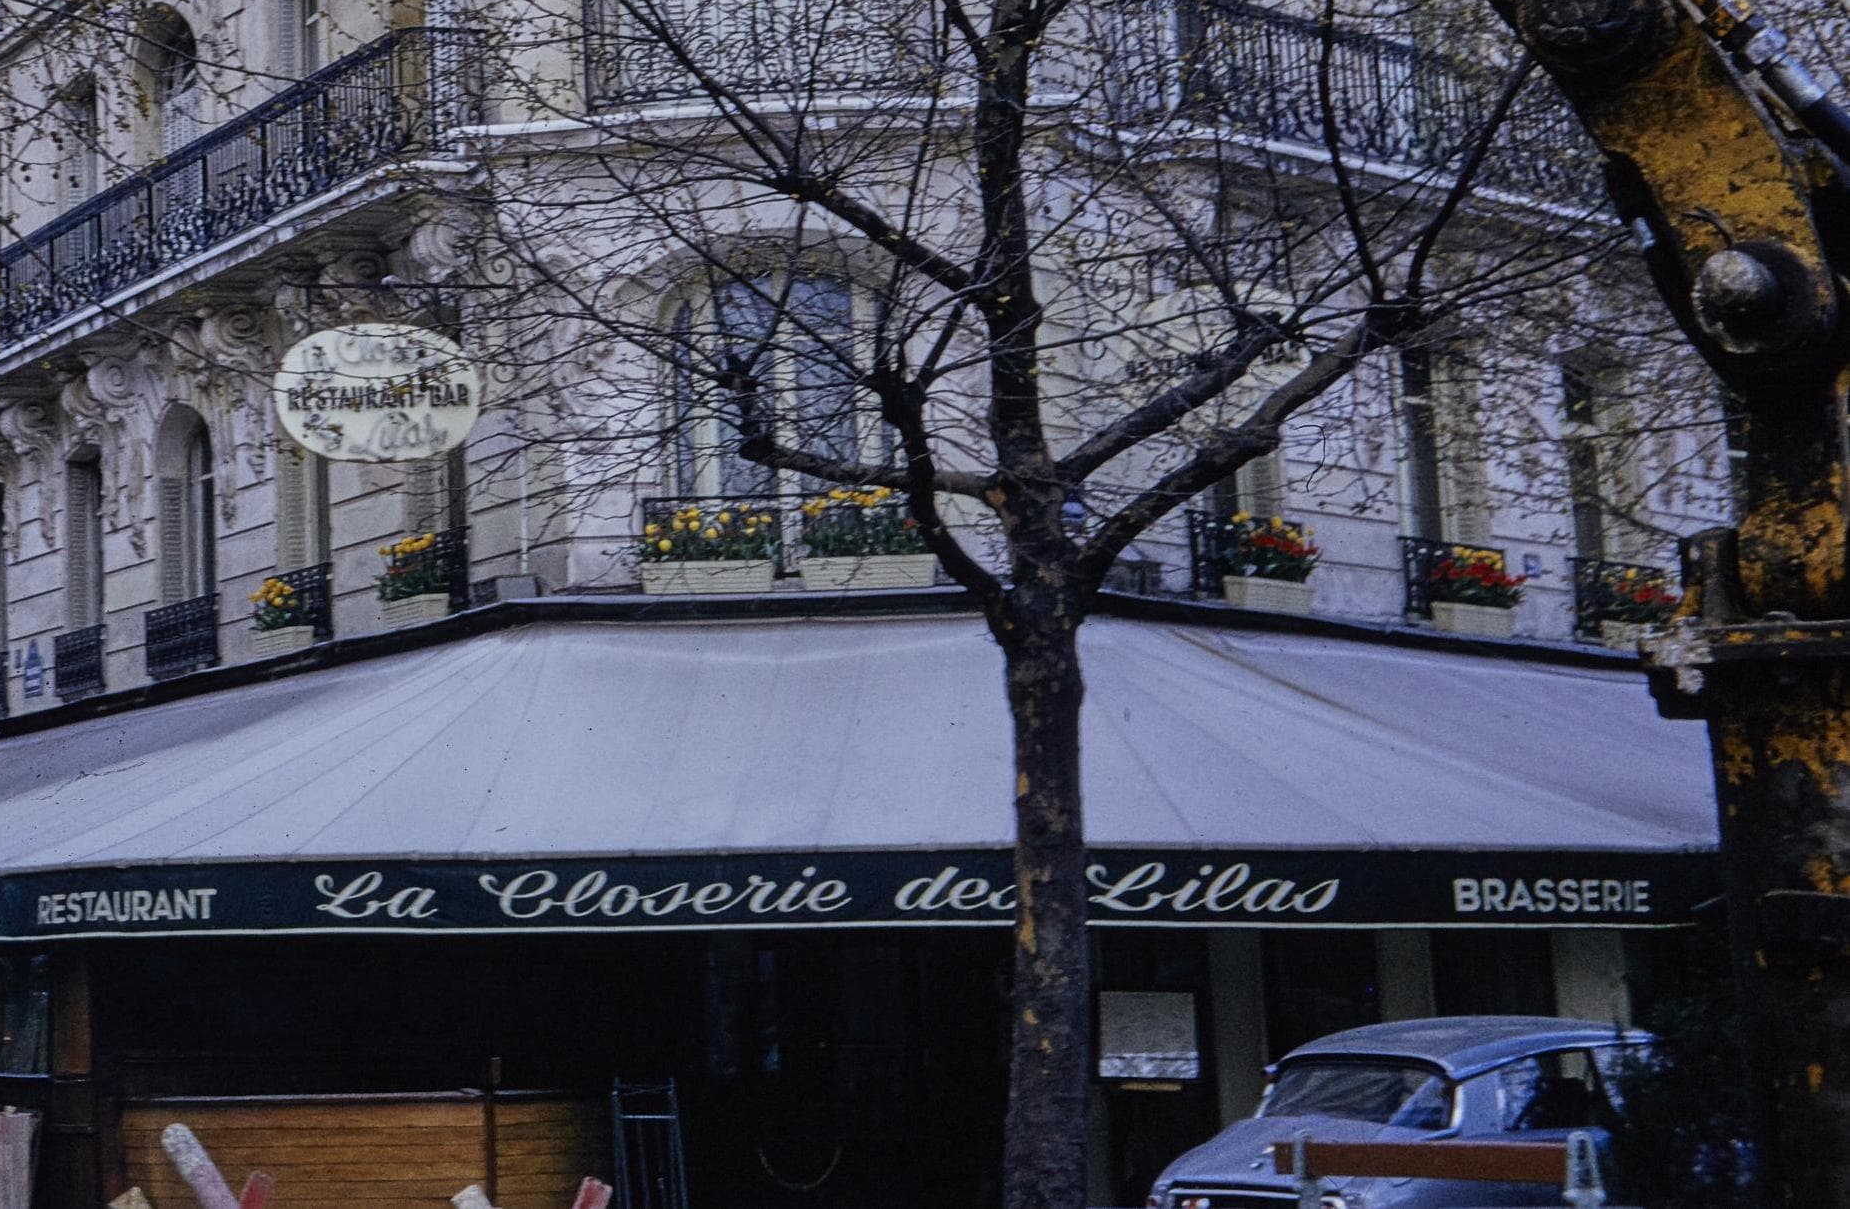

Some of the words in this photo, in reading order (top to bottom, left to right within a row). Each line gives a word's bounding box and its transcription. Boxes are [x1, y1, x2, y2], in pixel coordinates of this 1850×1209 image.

[37, 888, 218, 925] RESTAURANT
[315, 871, 438, 919] La
[478, 866, 852, 918] Closerie
[1085, 862, 1340, 912] Lilas
[1453, 878, 1650, 912] BRASSERIE
